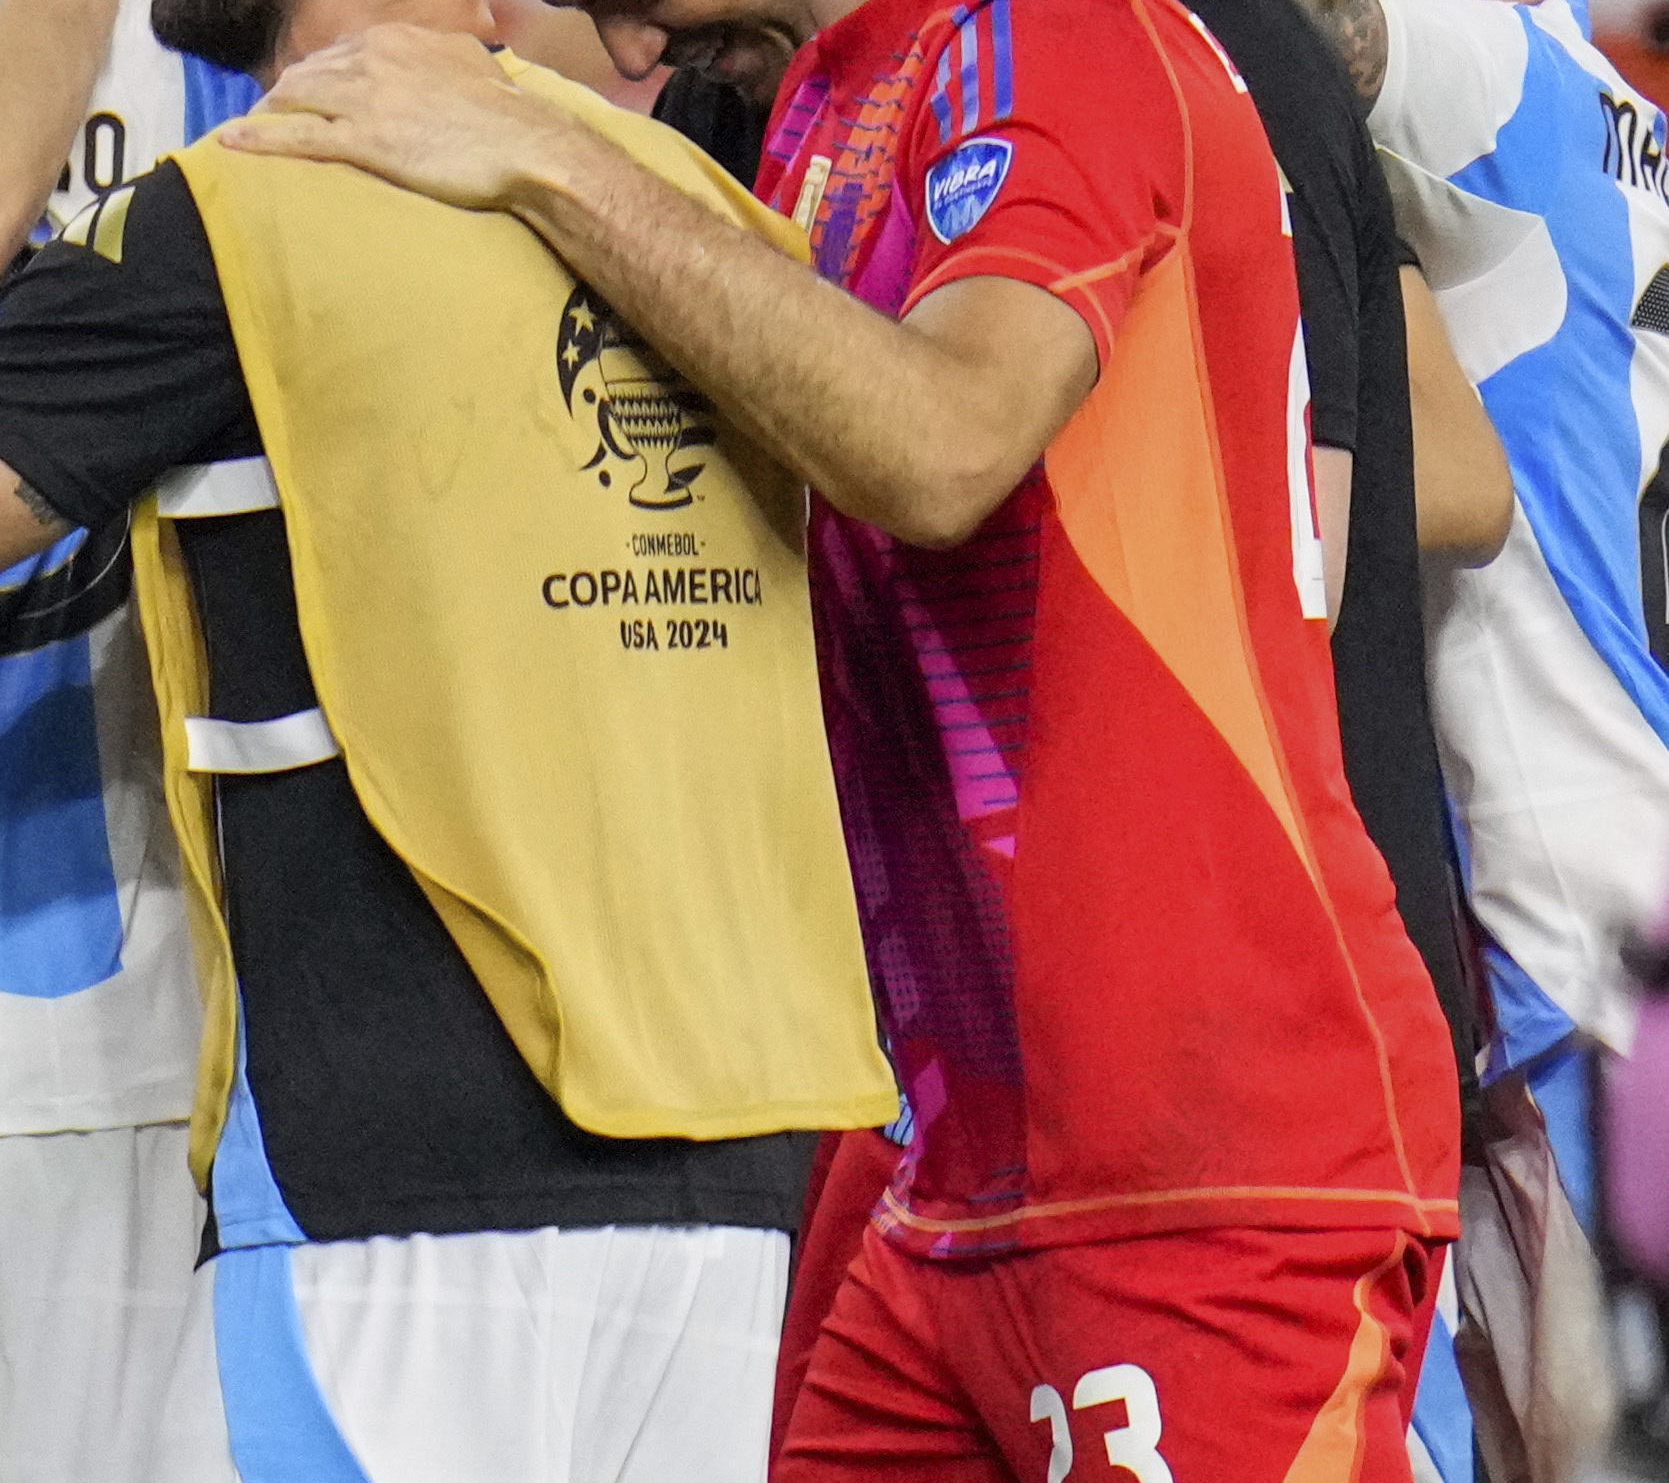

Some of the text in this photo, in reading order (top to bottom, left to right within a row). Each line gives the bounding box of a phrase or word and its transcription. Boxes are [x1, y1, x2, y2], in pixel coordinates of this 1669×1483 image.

[934, 159, 997, 202] VIBRA
[632, 532, 699, 557] CONMEBOL
[543, 567, 762, 609] COPA AMERICA
[620, 617, 728, 651] USA 2024
